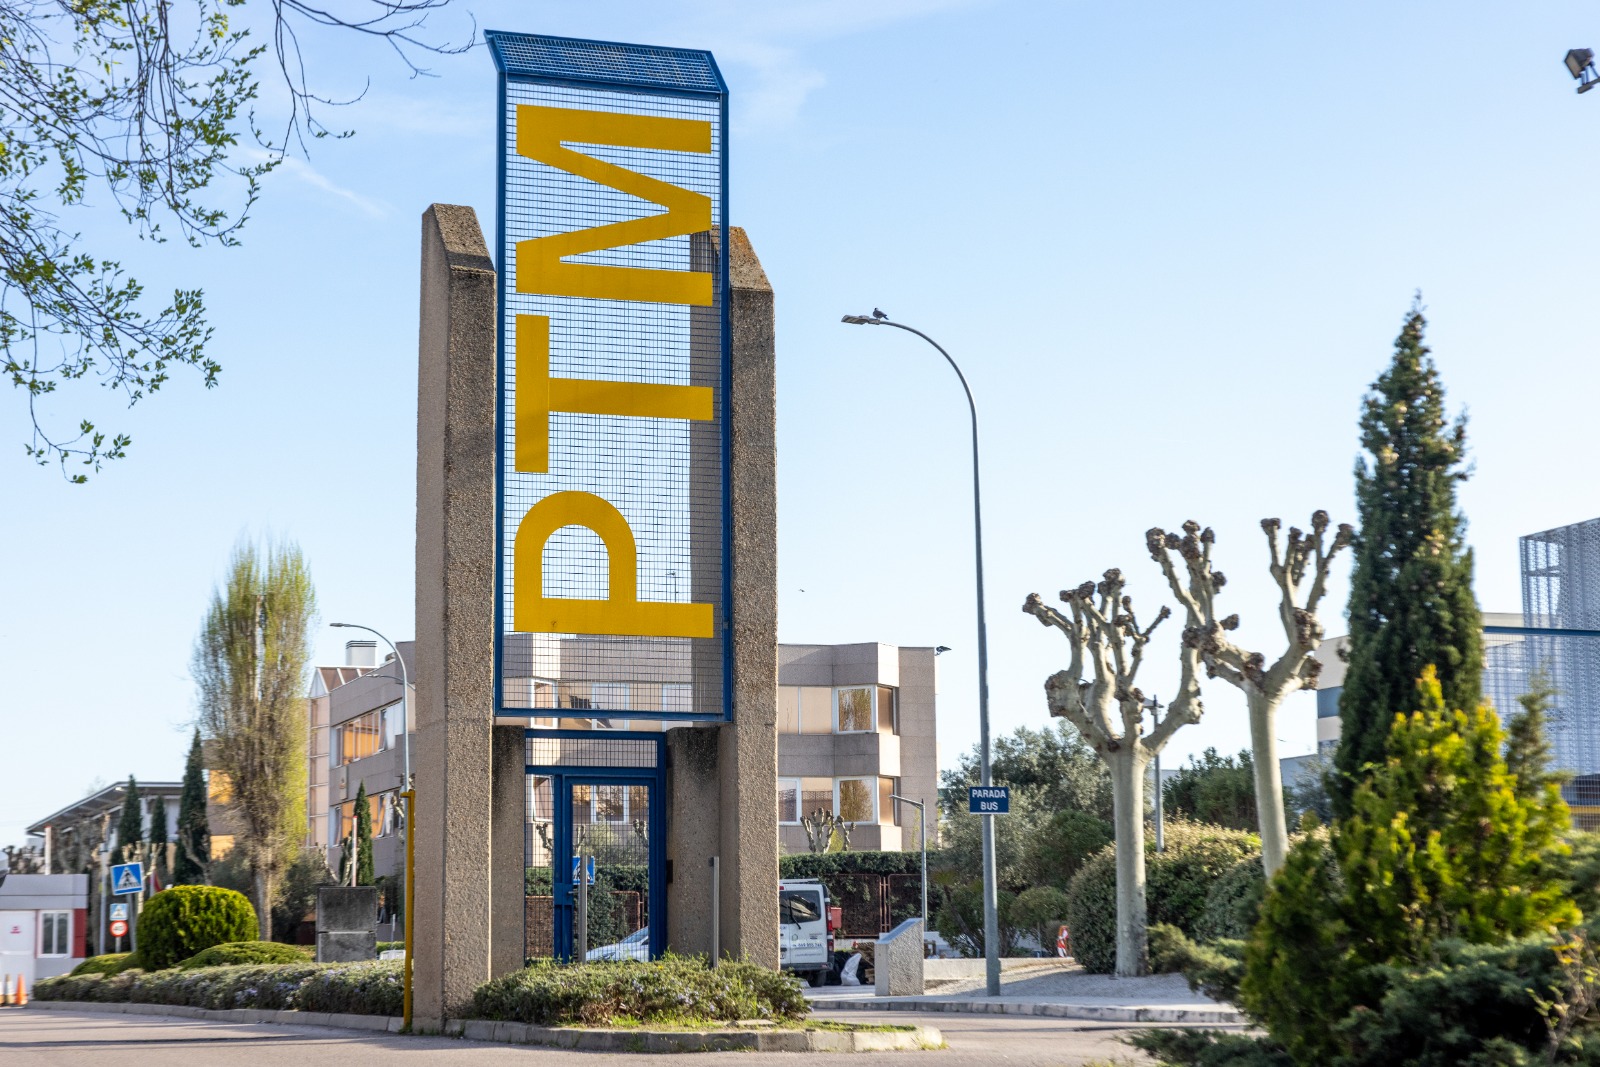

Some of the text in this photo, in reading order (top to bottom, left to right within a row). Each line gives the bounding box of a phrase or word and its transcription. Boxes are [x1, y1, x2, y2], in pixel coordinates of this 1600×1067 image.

[513, 104, 714, 638] PTM
[971, 789, 1006, 798] PARADA
[980, 801, 998, 811] BUS
